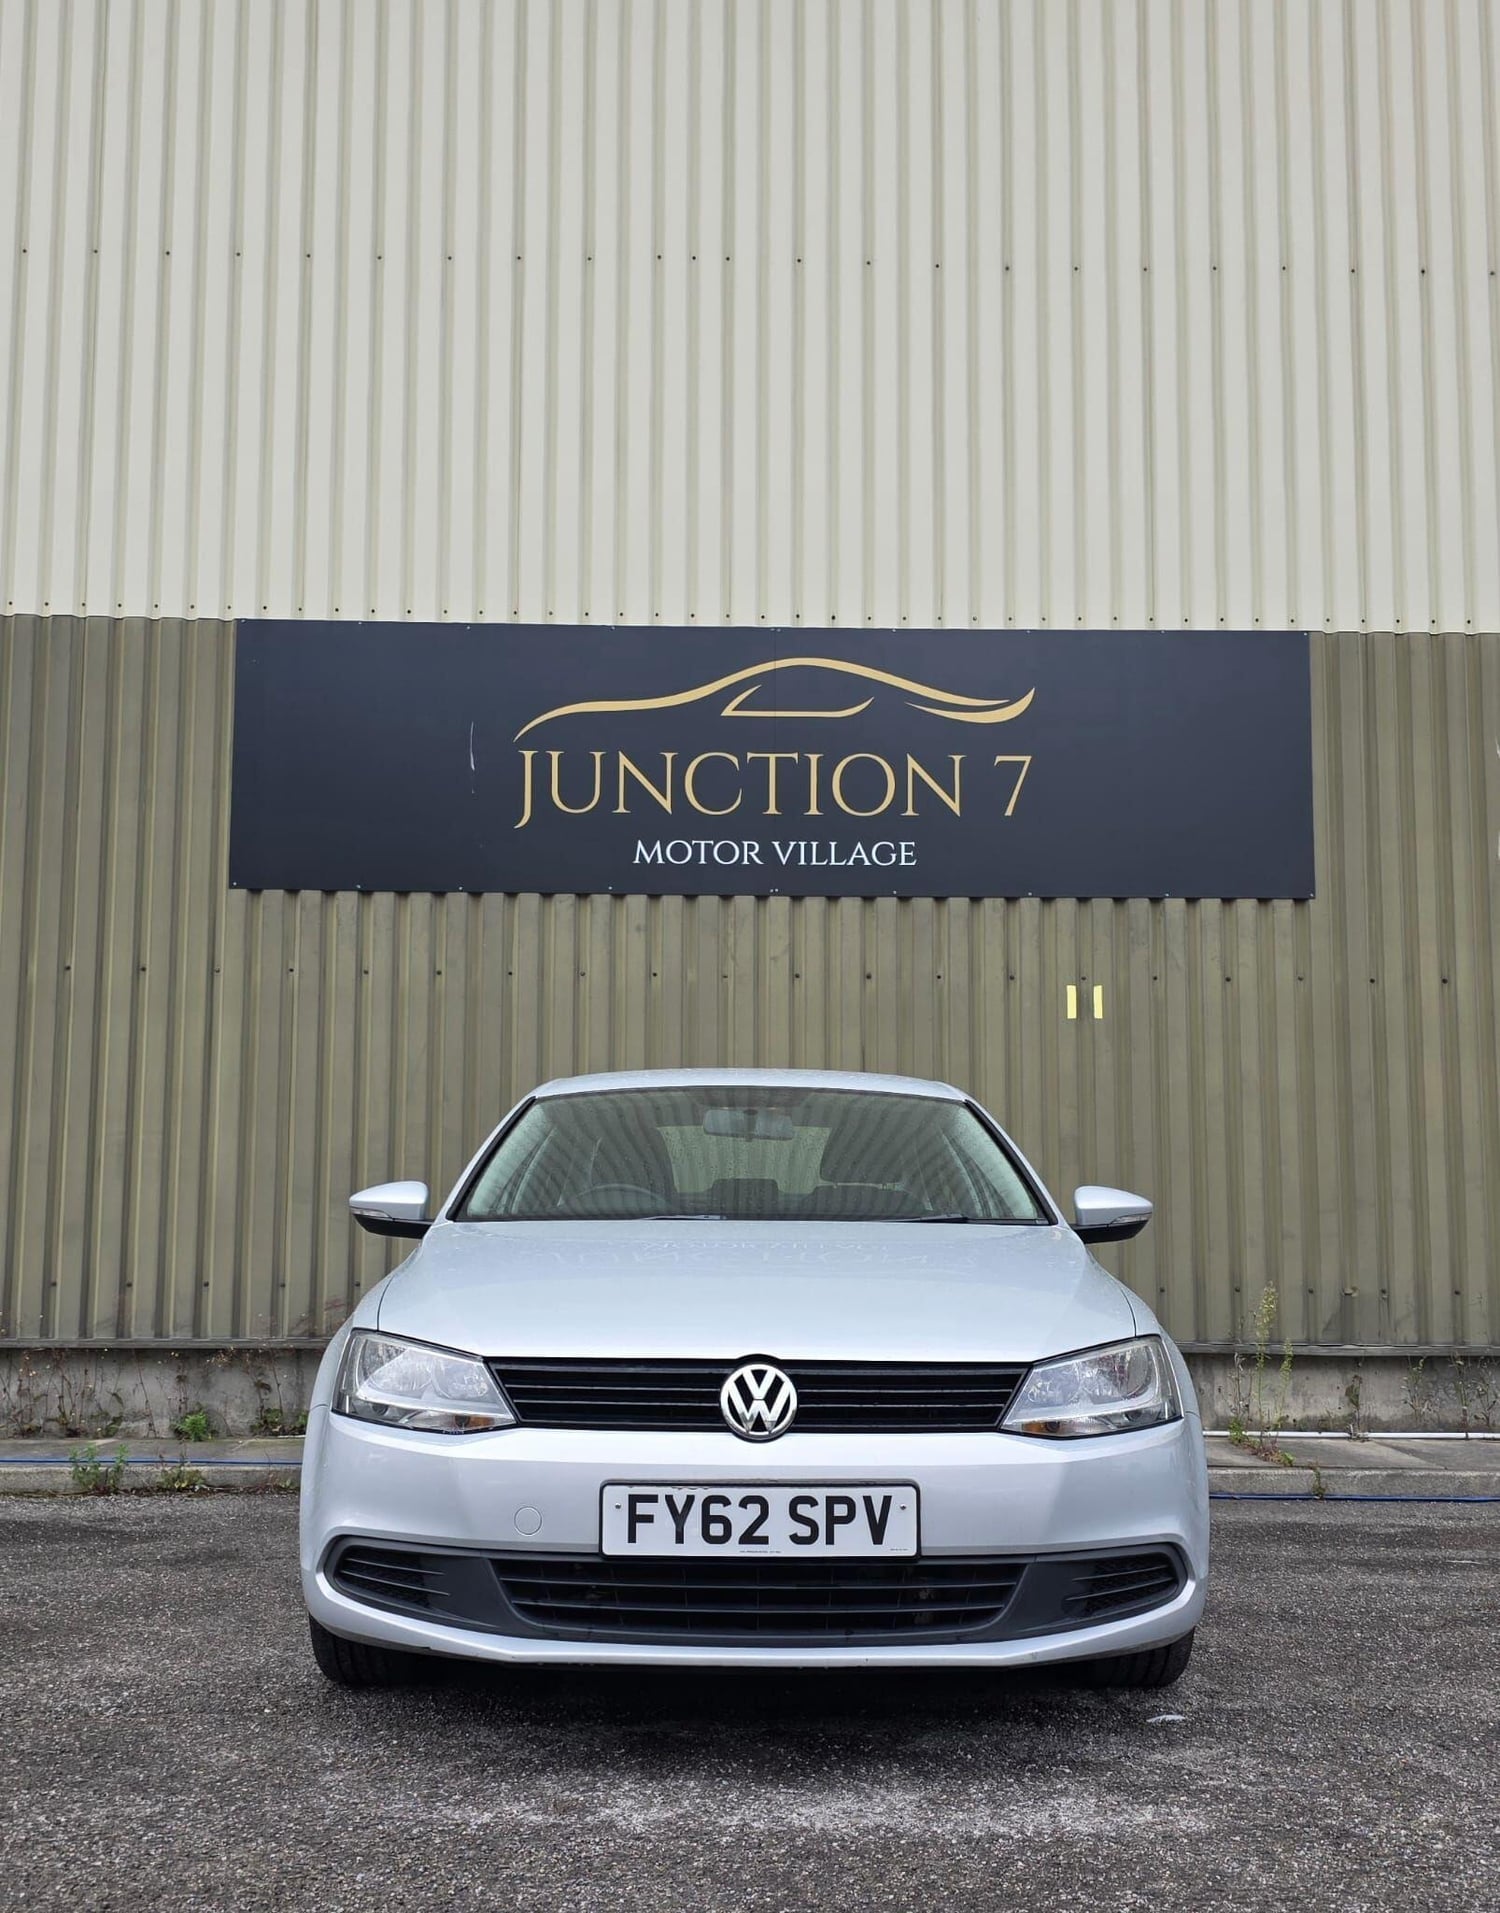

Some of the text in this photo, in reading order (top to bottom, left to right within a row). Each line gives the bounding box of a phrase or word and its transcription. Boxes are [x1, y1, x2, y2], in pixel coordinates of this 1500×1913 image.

[513, 750, 1033, 829] JUNCTION 7
[632, 839, 917, 867] MOTOR VILLAGE
[722, 1365, 796, 1437] VW
[627, 1493, 893, 1546] FY62 SPV
